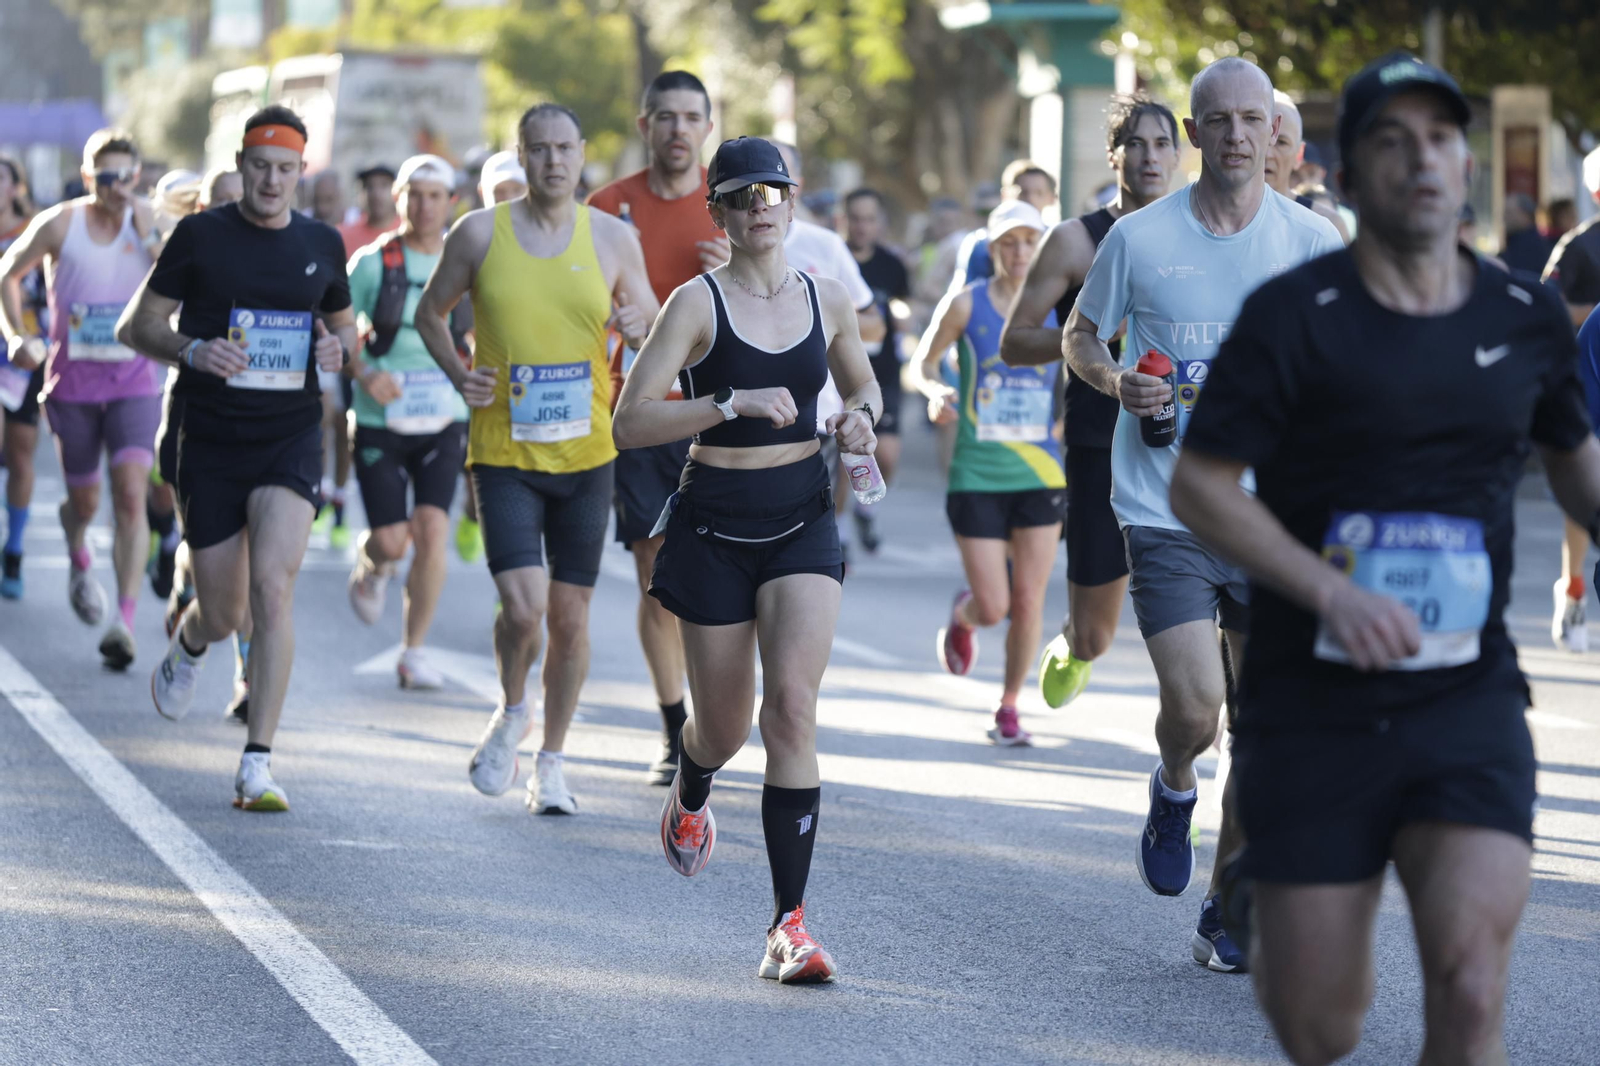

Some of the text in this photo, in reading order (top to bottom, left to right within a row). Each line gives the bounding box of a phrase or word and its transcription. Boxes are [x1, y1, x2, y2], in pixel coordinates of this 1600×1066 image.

[259, 315, 304, 327] ZURICH
[259, 339, 282, 348] 6591
[248, 350, 291, 369] KÉVIN
[538, 367, 584, 380] ZURICH
[533, 405, 571, 421] JOSE
[1382, 522, 1467, 550] ZURICH
